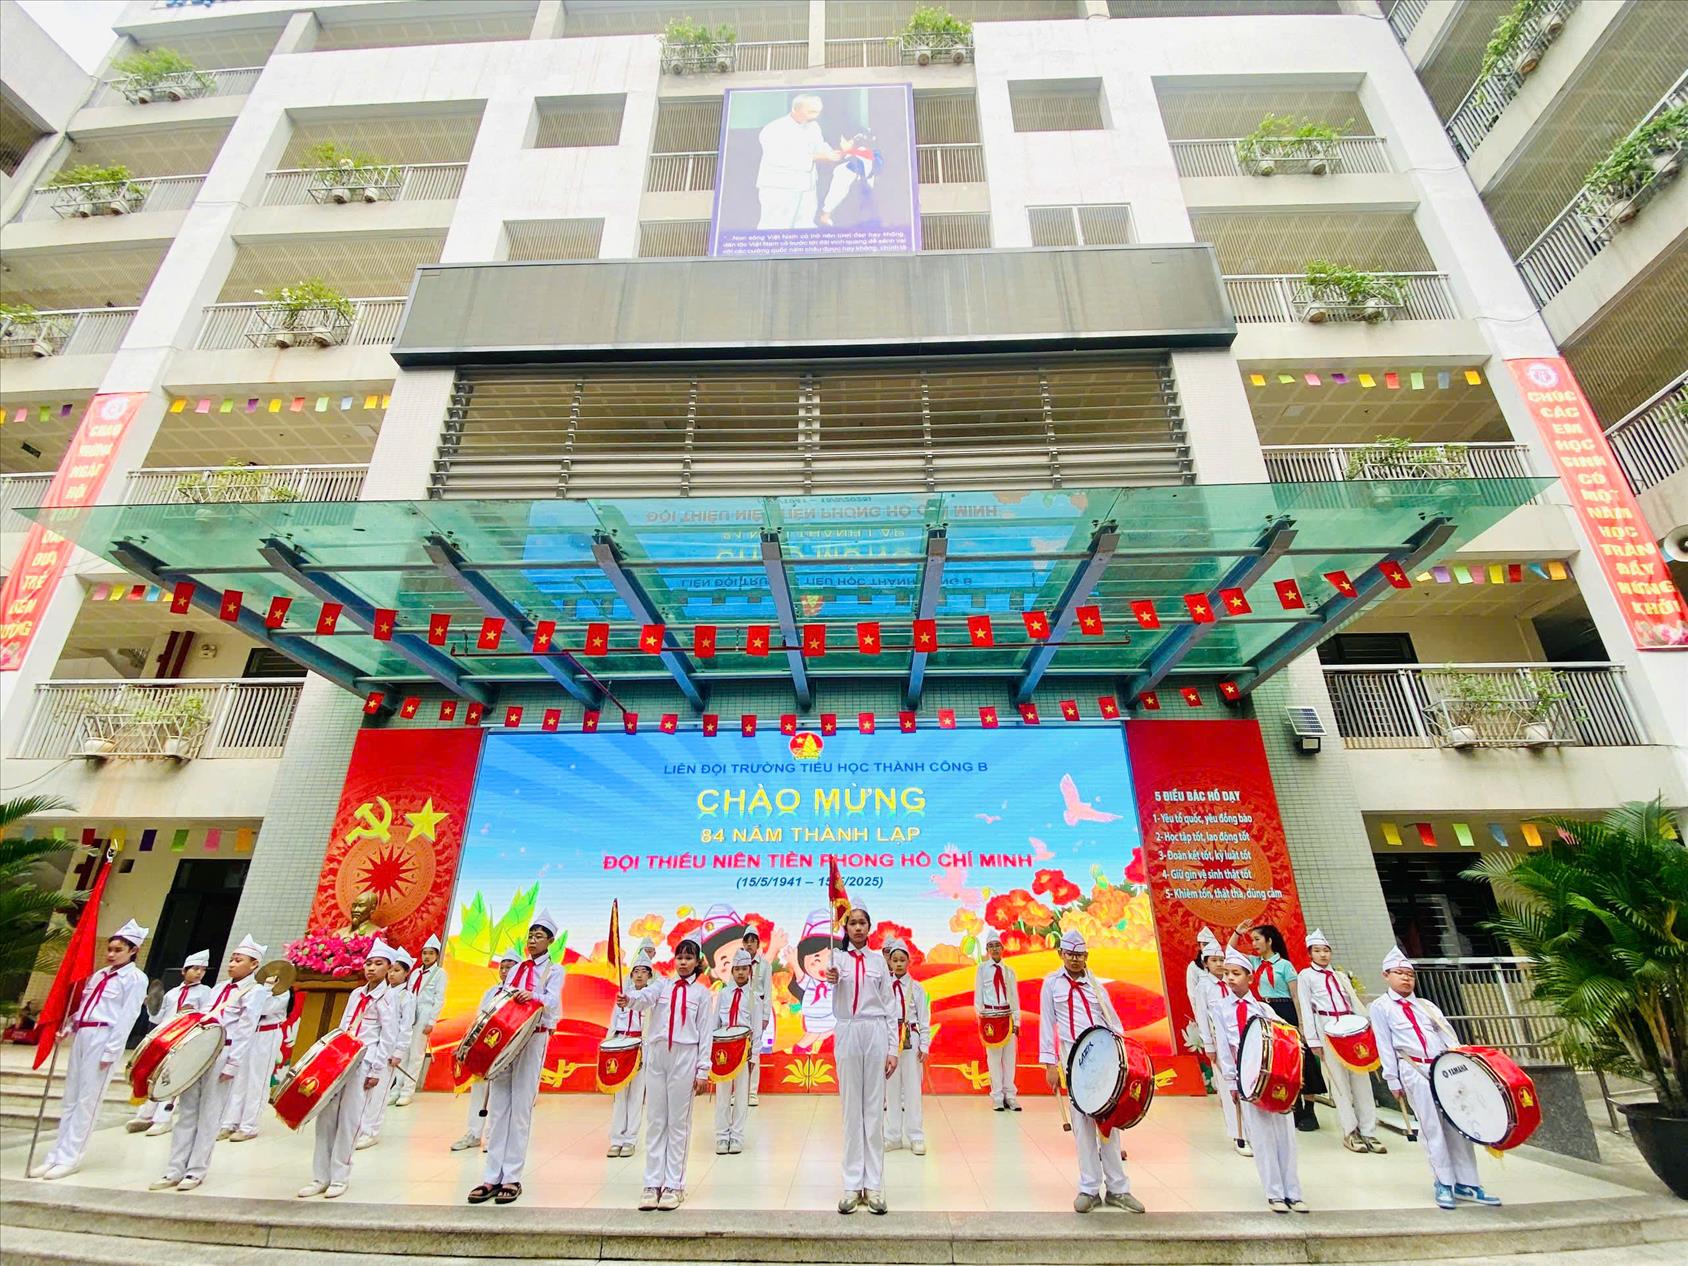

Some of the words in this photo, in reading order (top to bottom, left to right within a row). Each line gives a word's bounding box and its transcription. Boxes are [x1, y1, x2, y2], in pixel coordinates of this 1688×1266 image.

[1540, 405, 1580, 418] CÁC
[1551, 423, 1584, 434] EM
[1554, 438, 1596, 453] HỌC
[1577, 470, 1607, 484] CÓ
[1598, 526, 1638, 540] HỌC
[664, 762, 697, 775] LIÊN
[731, 761, 796, 774] TRƯỜNG
[838, 762, 870, 774] HỌC
[873, 760, 925, 772] THÀNH
[929, 760, 974, 772] CÔNG
[978, 762, 988, 772] B
[697, 783, 801, 814] CHÀO
[814, 782, 926, 812] MỪNG
[1154, 791, 1161, 802] 5
[1186, 789, 1206, 802] BÁC
[1222, 790, 1240, 803] DẠY
[701, 828, 725, 843] 84
[733, 824, 783, 843] NĂM
[791, 824, 869, 842] THÀNH
[713, 851, 761, 868] NIÊN
[820, 852, 895, 868] PHONG
[938, 850, 973, 868] CHÍ
[979, 853, 1033, 868] MINH
[736, 877, 802, 889] (15/5/1941
[818, 876, 884, 889] 15/2025)
[1448, 1064, 1469, 1077] YAMAHA
